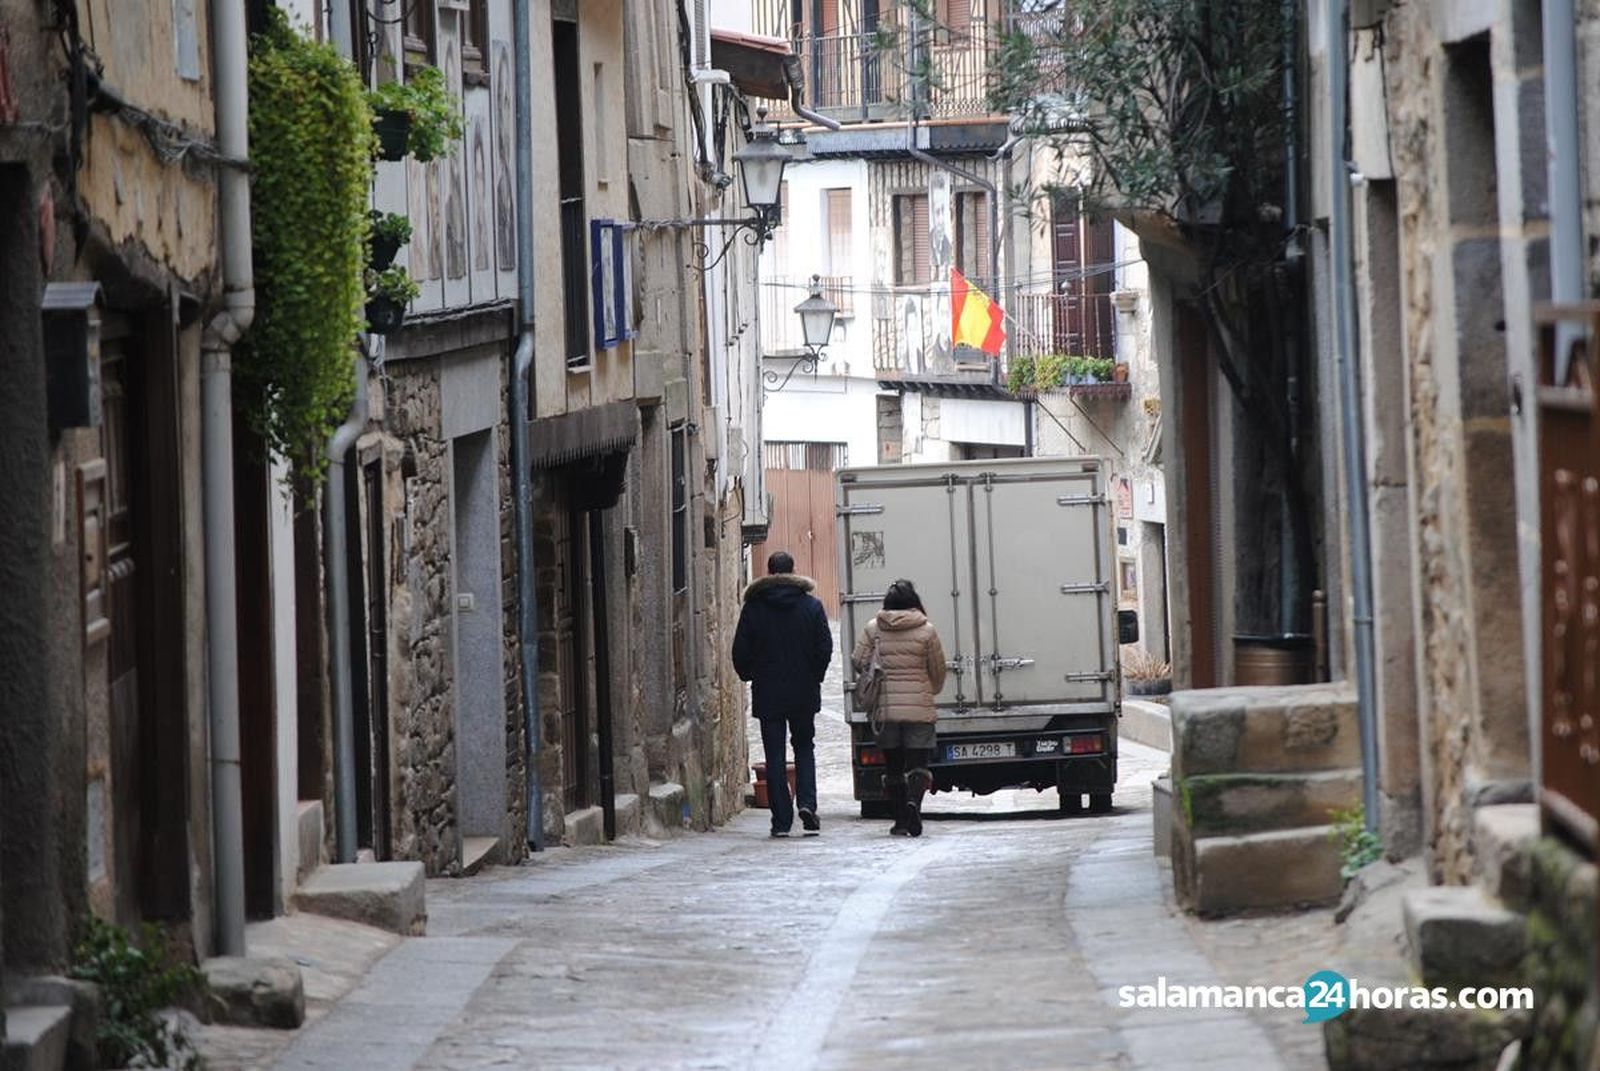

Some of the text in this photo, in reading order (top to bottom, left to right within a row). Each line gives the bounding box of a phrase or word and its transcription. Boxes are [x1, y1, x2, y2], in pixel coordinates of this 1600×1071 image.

[953, 743, 1012, 758] SA 4298 T
